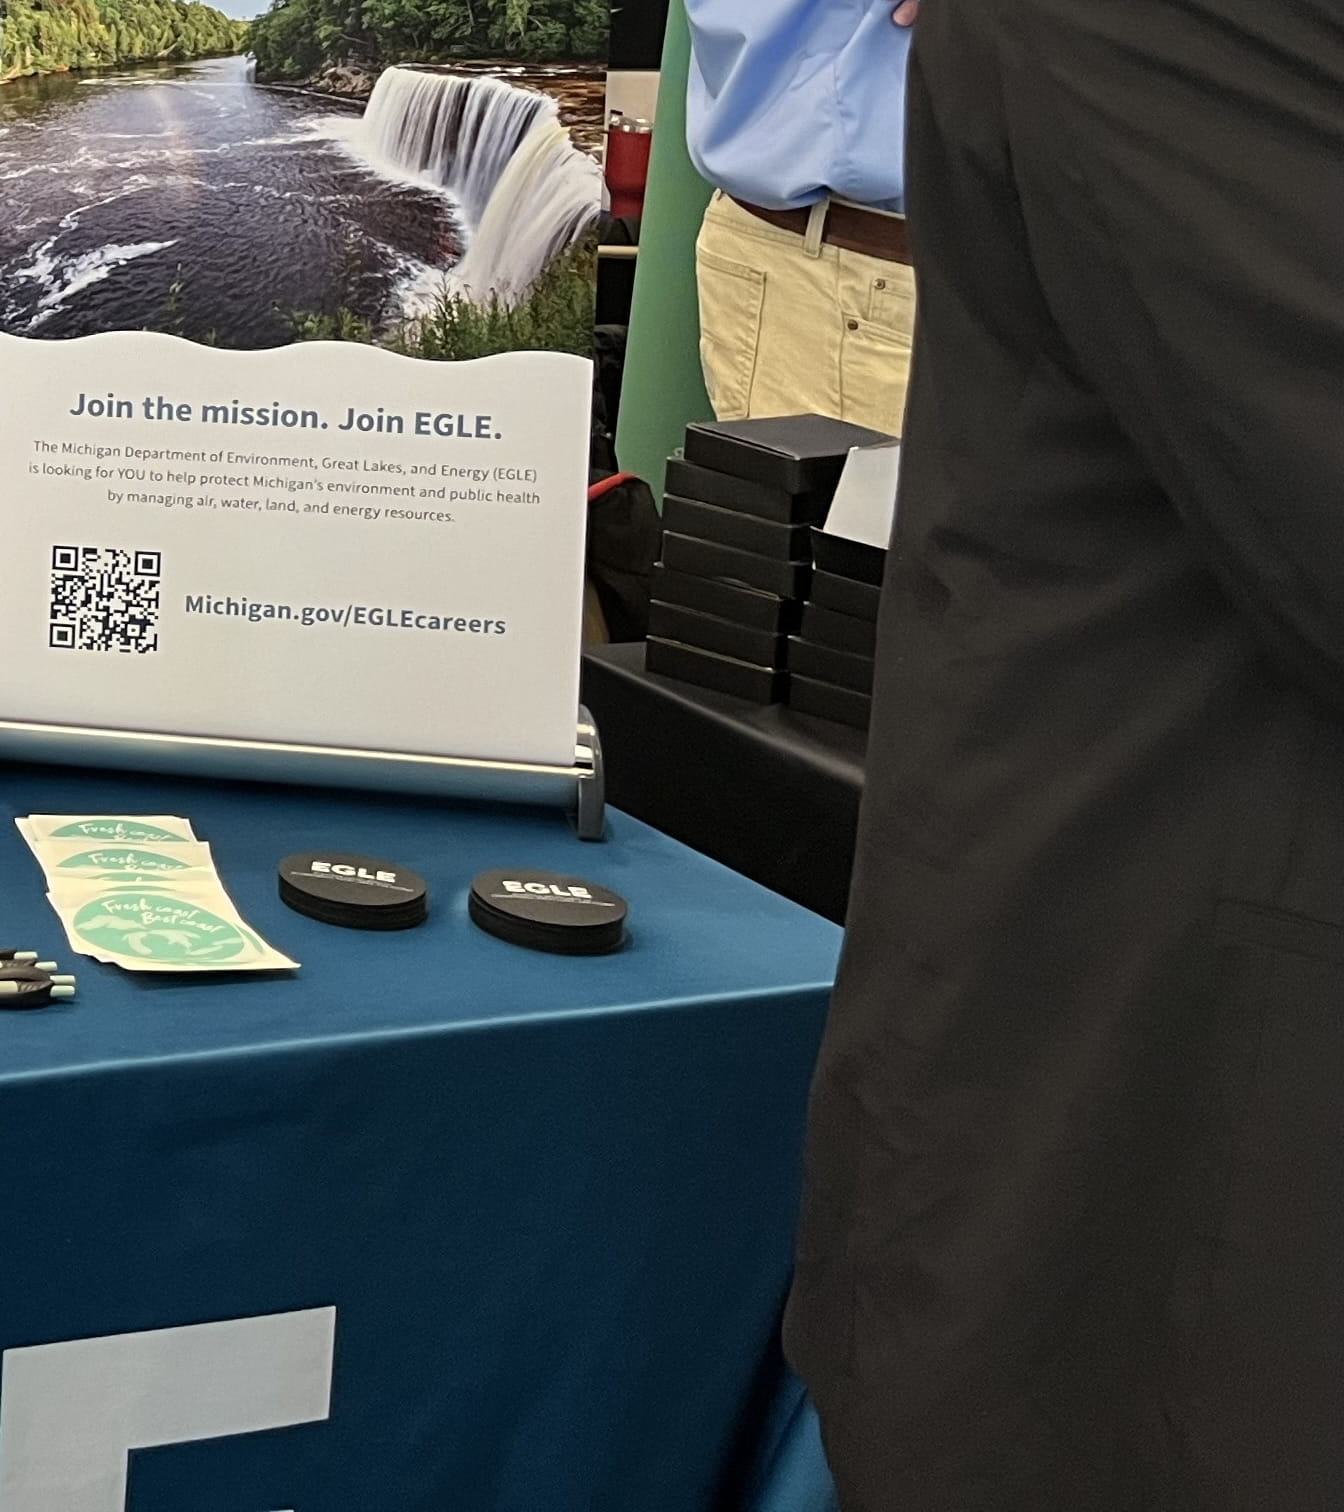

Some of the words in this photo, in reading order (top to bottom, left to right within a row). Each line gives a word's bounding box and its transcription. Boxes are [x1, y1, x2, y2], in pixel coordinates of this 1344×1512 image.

[69, 392, 134, 421] Join
[142, 395, 192, 423] the
[201, 397, 329, 430] mission.
[338, 406, 405, 435] Join
[414, 411, 502, 441] EGLE.
[33, 440, 58, 454] The
[62, 442, 121, 459] Michigan
[125, 446, 206, 463] Department
[209, 451, 225, 463] of
[227, 451, 318, 470] Environment,
[322, 457, 359, 470] Great
[363, 460, 406, 476] Lakes,
[410, 463, 436, 476] and
[441, 465, 489, 482] Energy
[493, 467, 537, 483] (EGLE)
[28, 461, 40, 474] is
[42, 463, 93, 481] looking
[96, 466, 114, 478] for
[118, 468, 146, 481] YOU
[149, 470, 163, 482] to
[166, 471, 196, 485] help
[200, 474, 249, 490] protect
[253, 476, 323, 493] Michigan's
[327, 481, 415, 497] environment
[419, 486, 445, 499] and
[449, 488, 493, 503] public
[496, 491, 540, 504] health
[107, 489, 124, 503] by
[127, 493, 193, 509] managing
[196, 496, 217, 509] air,
[220, 499, 262, 511] water,
[265, 499, 300, 513] land,
[303, 502, 329, 514] and
[333, 504, 380, 520] energy
[384, 507, 455, 523] resources.
[185, 593, 506, 635] Michigan.gov/EGLEcareers
[311, 861, 396, 884] EGLE
[502, 880, 593, 899] EGLE
[101, 898, 152, 914] Fresh
